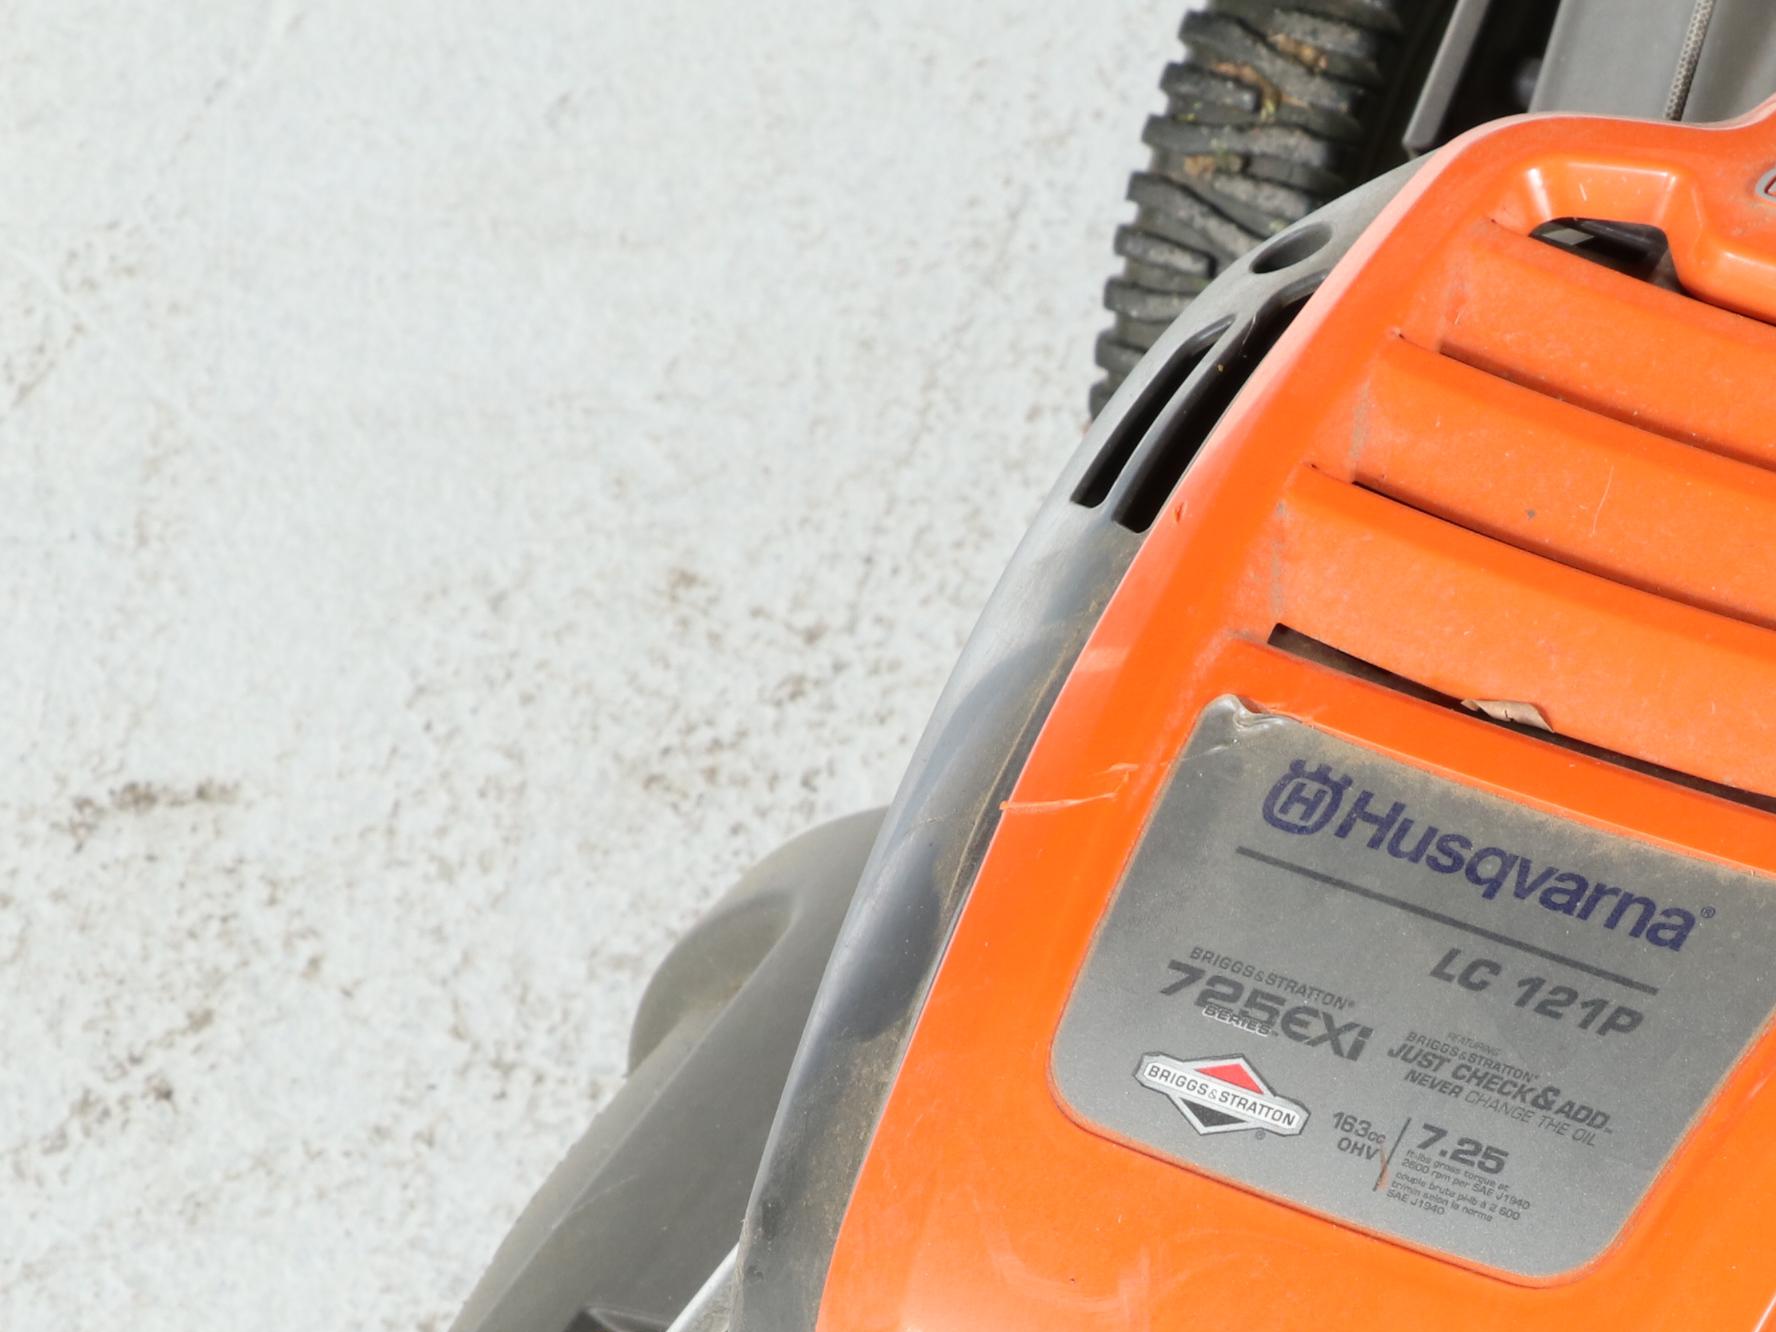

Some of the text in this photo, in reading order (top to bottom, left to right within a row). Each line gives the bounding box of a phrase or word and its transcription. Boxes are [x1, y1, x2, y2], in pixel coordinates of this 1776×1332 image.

[1334, 790, 1700, 951] Husqvarna
[1431, 948, 1643, 1035] LC 121P
[1204, 1003, 1273, 1034] SERIES
[1388, 1044, 1451, 1072] JUST
[1405, 1070, 1596, 1146] NEVER CHANGE THE OIL
[1334, 1112, 1386, 1144] 163cc
[1338, 1137, 1380, 1160] OHV
[1418, 1124, 1508, 1174] 7.25
[1387, 1190, 1408, 1202] SAE
[1473, 1183, 1494, 1196] SAE
